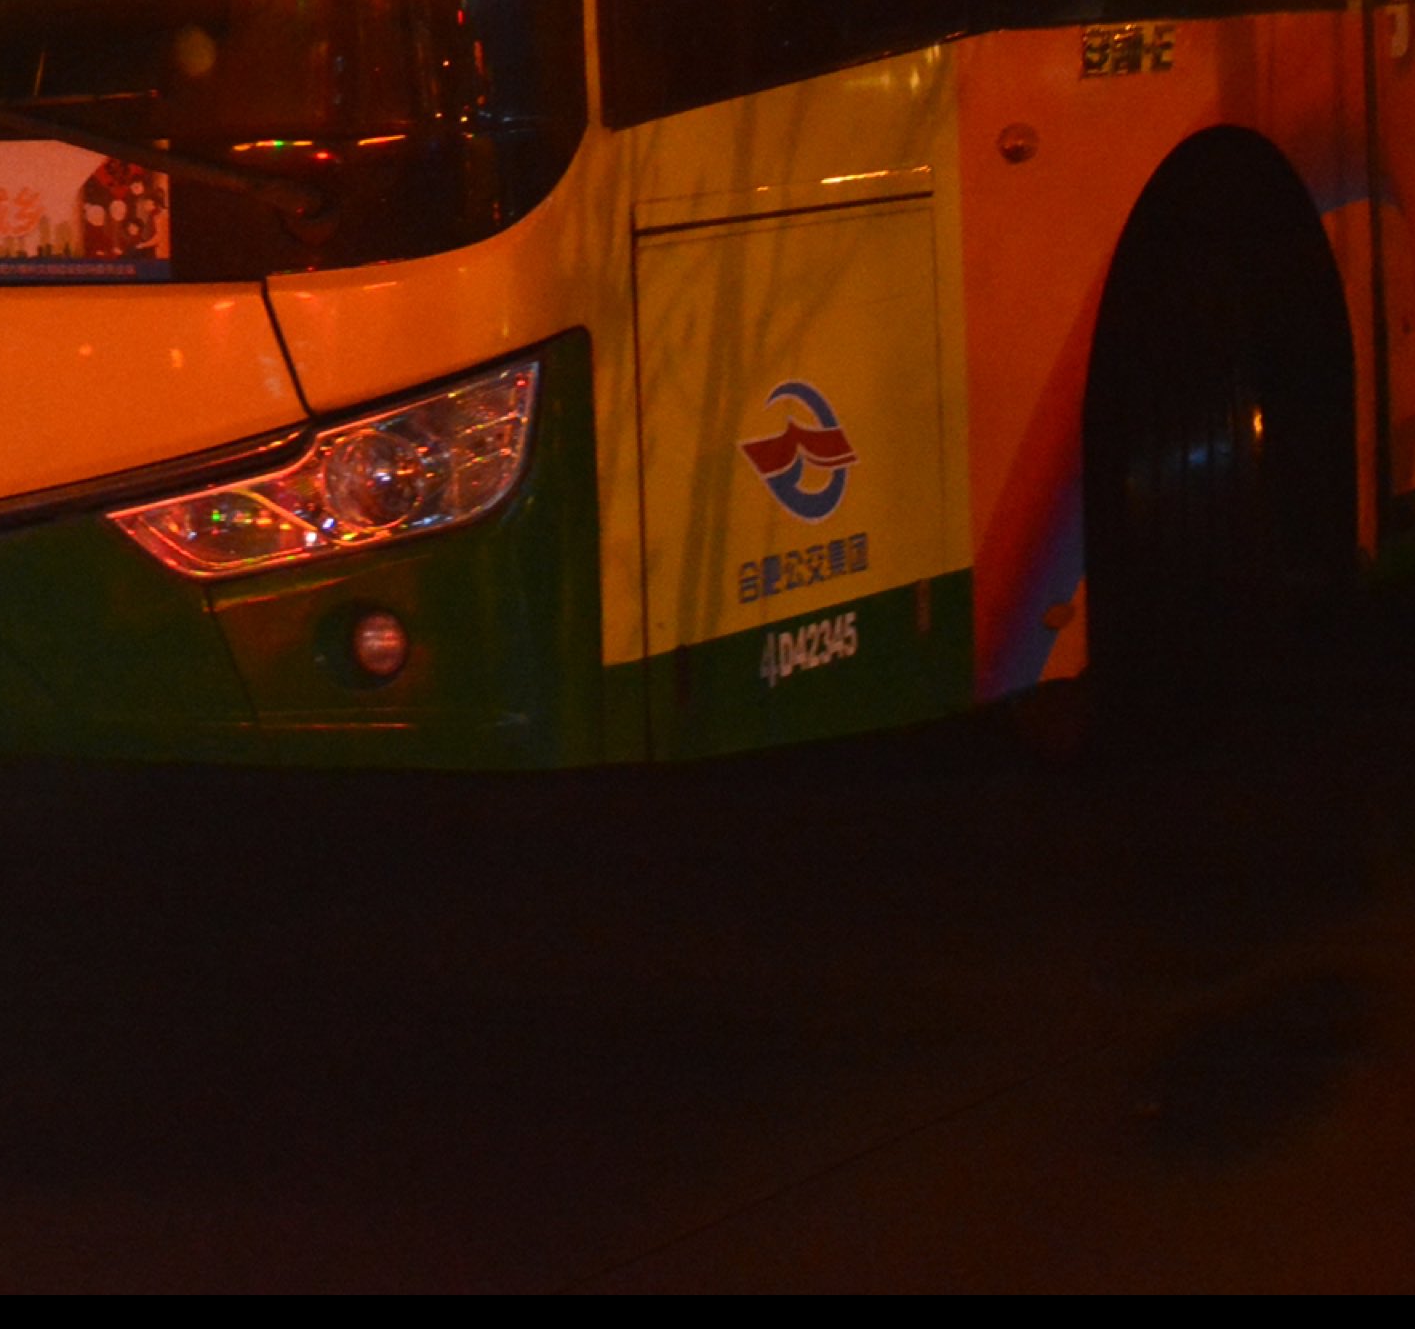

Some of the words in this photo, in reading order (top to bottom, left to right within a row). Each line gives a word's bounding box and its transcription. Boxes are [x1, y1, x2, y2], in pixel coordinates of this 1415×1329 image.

[738, 531, 869, 605] 合肥公交集团
